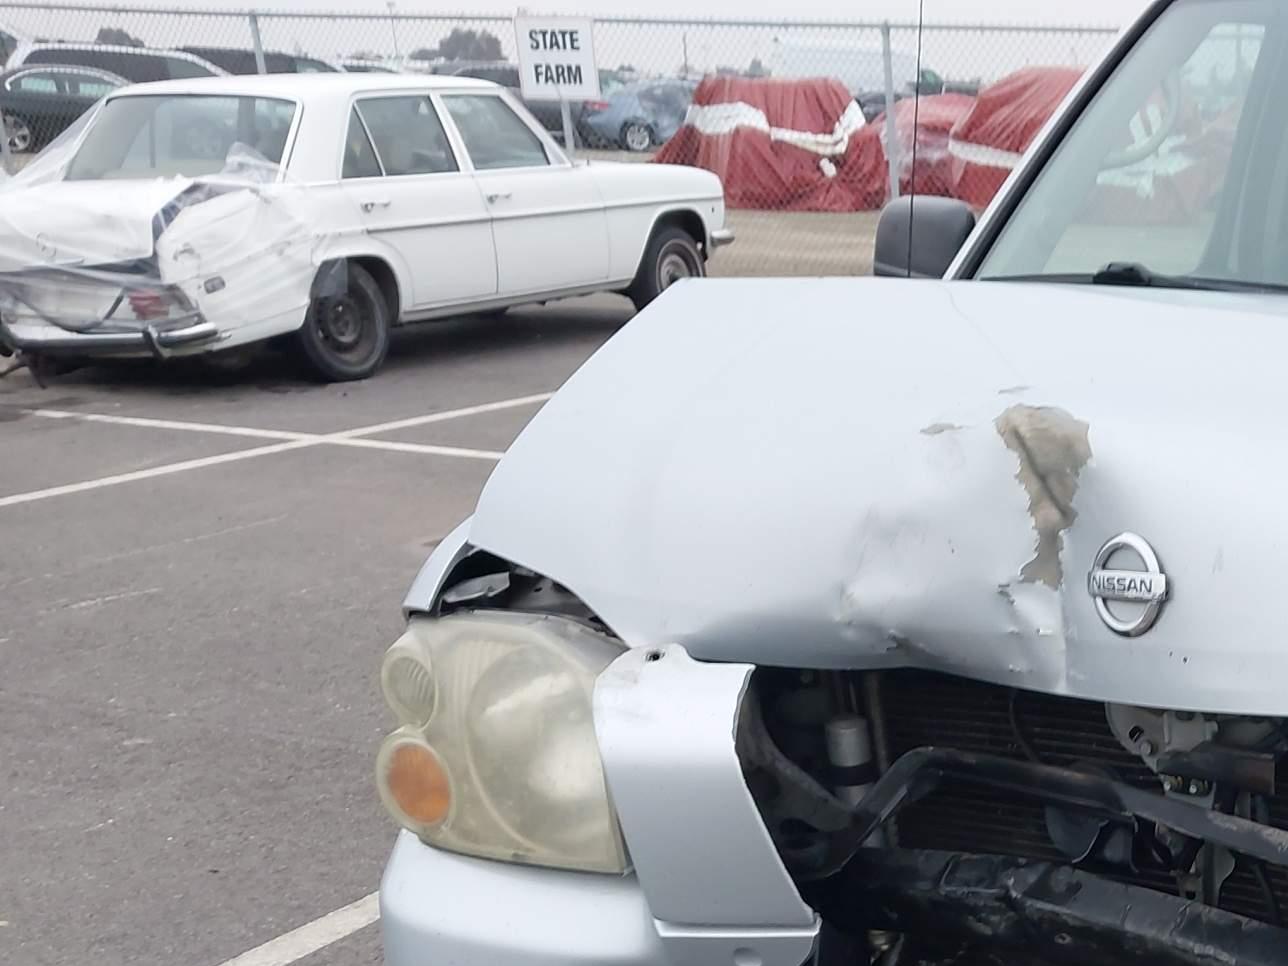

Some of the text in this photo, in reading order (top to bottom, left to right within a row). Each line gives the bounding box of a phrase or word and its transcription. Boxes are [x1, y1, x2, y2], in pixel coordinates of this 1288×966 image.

[528, 29, 580, 51] STATE
[534, 64, 583, 85] FARM
[1092, 575, 1152, 593] NISSAN
